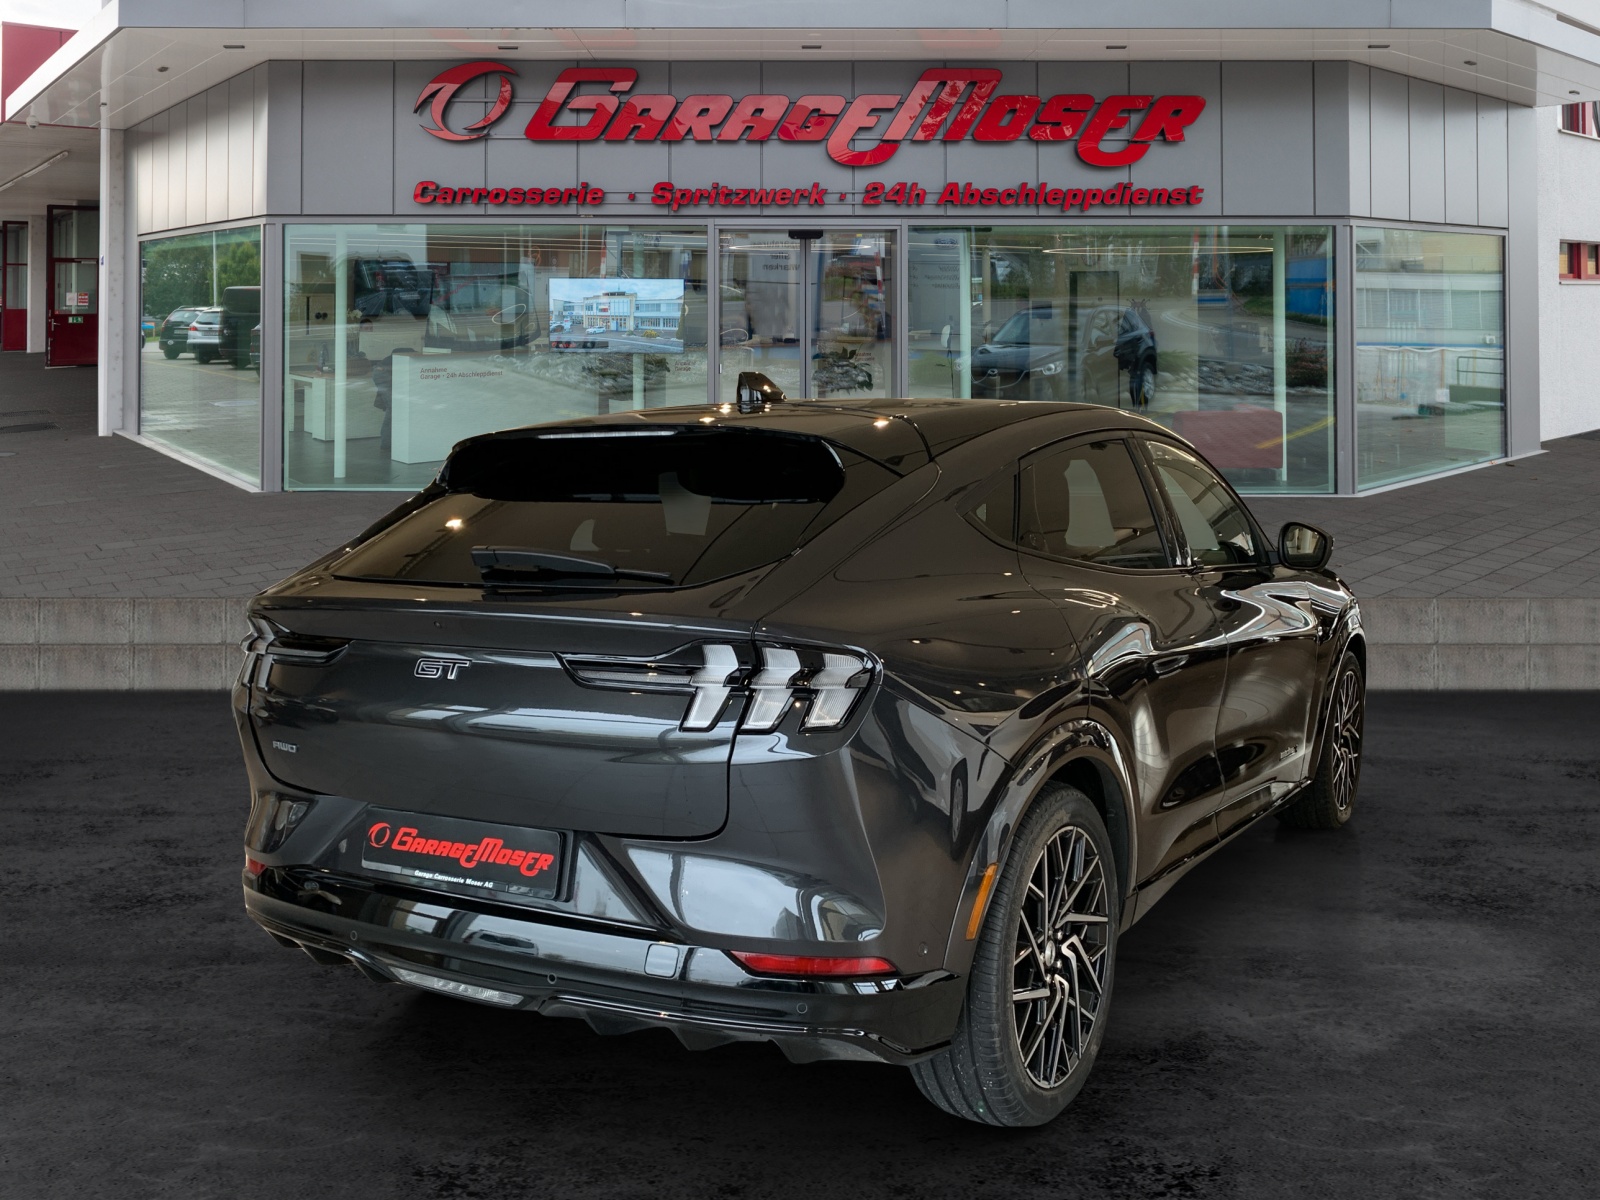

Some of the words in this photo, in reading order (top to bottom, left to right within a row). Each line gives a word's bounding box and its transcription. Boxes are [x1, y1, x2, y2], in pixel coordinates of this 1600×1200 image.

[413, 181, 605, 205] Carrosserie
[651, 182, 826, 211] Spritzwerk
[862, 182, 926, 206] 24h
[937, 182, 1204, 211] Abschleppdienst
[414, 658, 470, 680] GT
[414, 869, 433, 879] Garage
[434, 873, 465, 884] Carrosserie
[465, 877, 484, 887] Moser
